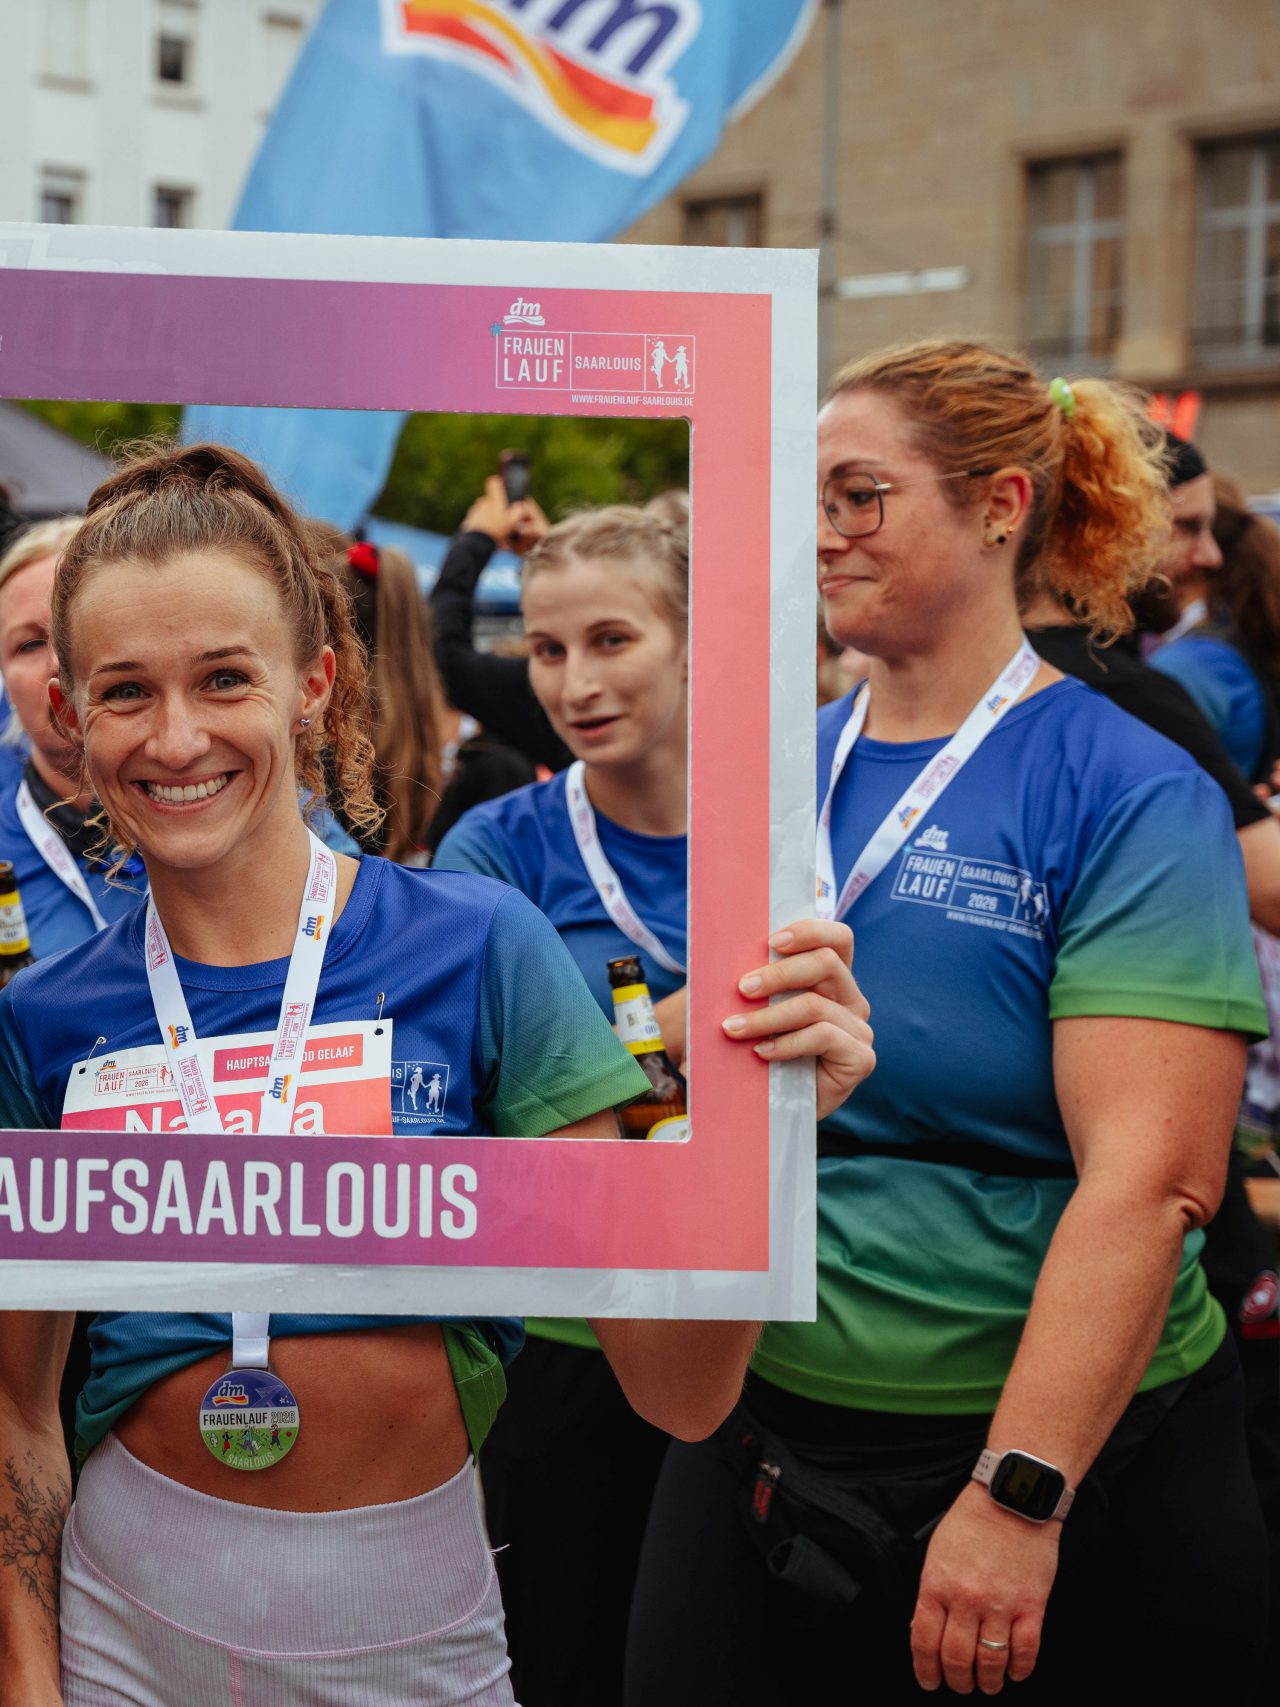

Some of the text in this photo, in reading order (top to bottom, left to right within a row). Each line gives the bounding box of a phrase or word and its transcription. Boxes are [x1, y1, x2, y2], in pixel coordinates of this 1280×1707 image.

[509, 297, 541, 316] dm
[503, 337, 565, 357] FRAUEN
[503, 358, 564, 383] LAUF
[575, 355, 642, 372] SAARLOUIS
[571, 394, 694, 407] WWW.FRAUENLAUF-SAARLOUIS.DE
[906, 854, 956, 878] FRAUEN
[960, 864, 1019, 889] SAARLOUIS
[318, 884, 327, 901] LAUF
[898, 873, 951, 899] LAUF
[302, 916, 317, 937] dm
[176, 1026, 189, 1044] dm
[285, 1040, 296, 1058] LAUF
[103, 1060, 117, 1068] dm
[226, 1056, 270, 1071] HAUPTSA
[317, 1046, 355, 1062] GELAAF
[99, 1071, 125, 1082] FRAUEN
[180, 1060, 193, 1078] LAUF
[98, 1080, 124, 1092] LAUF
[134, 1079, 149, 1088] 2026
[269, 1077, 284, 1099] dm
[220, 1382, 243, 1397] dm
[203, 1410, 296, 1426] FRAUENLAUF 2026
[226, 1452, 275, 1468] SAARLOUIS
